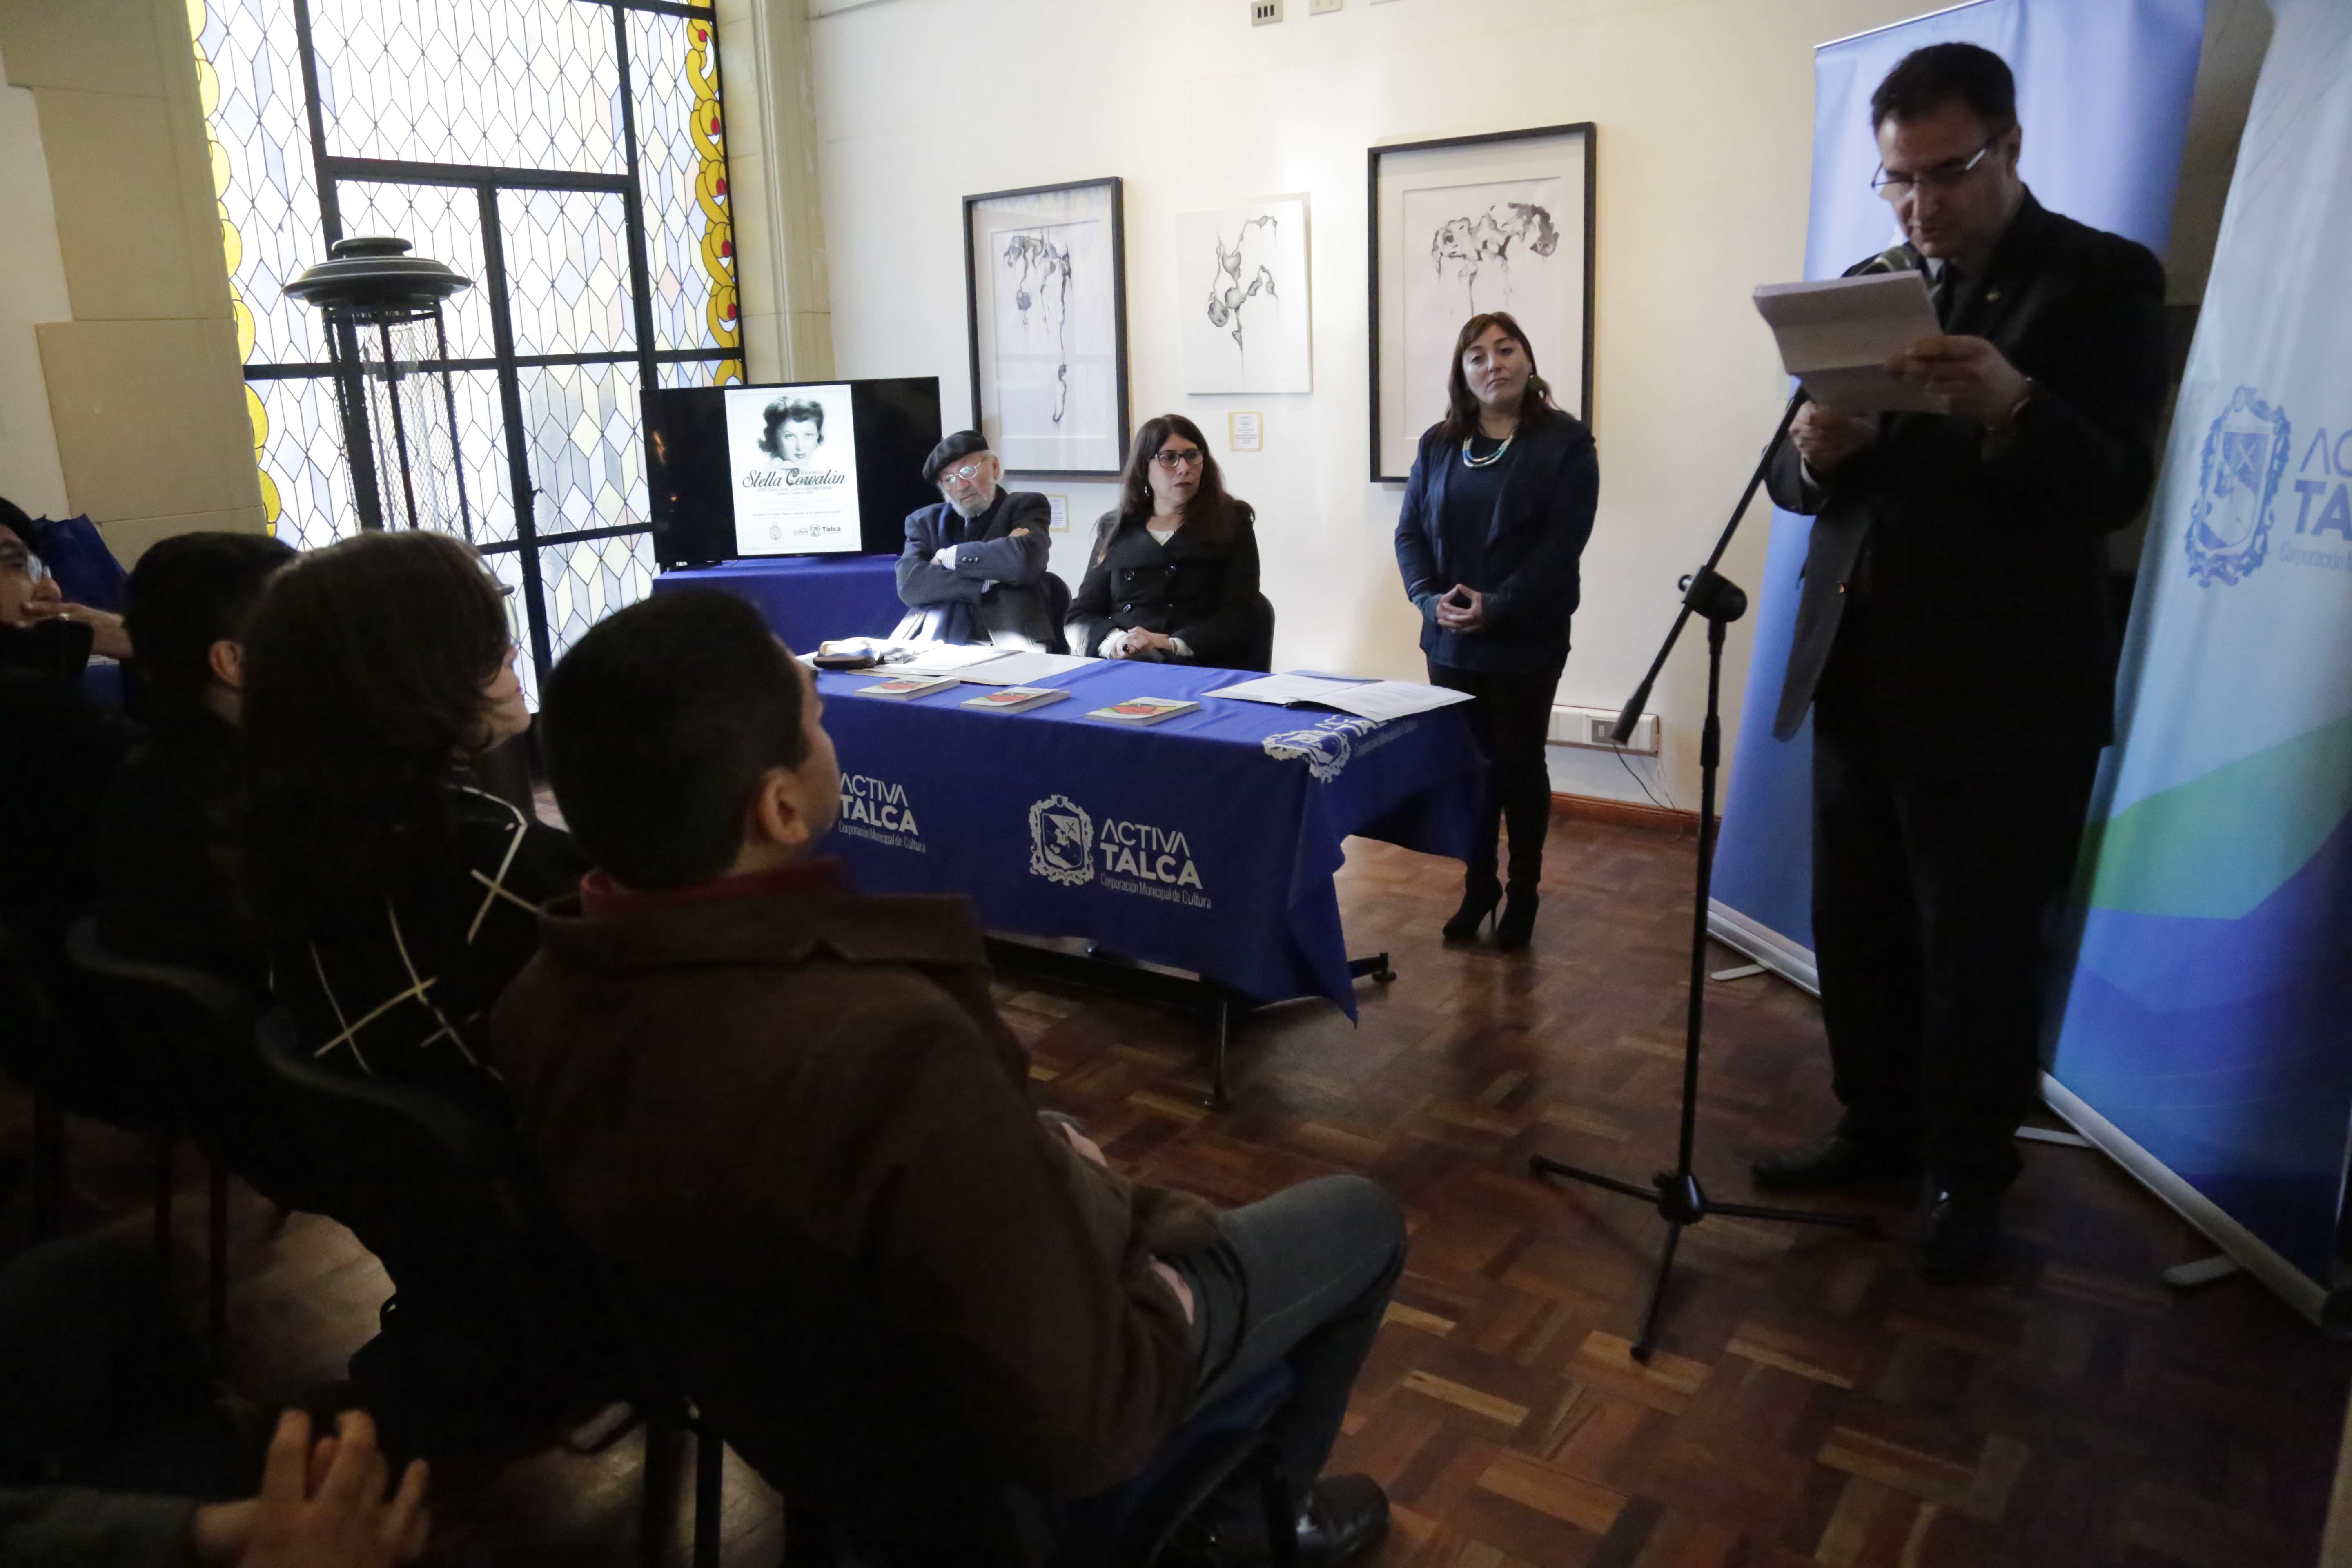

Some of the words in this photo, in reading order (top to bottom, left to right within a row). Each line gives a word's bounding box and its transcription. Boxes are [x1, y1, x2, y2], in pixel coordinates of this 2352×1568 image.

[742, 469, 782, 488] Stella
[840, 772, 908, 807] ACTIVA
[840, 794, 919, 836] TALCA
[895, 834, 902, 846] de
[903, 836, 926, 853] Cultura
[1101, 818, 1190, 857] ACTIVA
[1100, 842, 1203, 890] TALCA
[1101, 872, 1139, 893] Corporación
[1139, 882, 1172, 901] Municipal
[1172, 888, 1181, 902] de
[1182, 890, 1212, 909] Cultura
